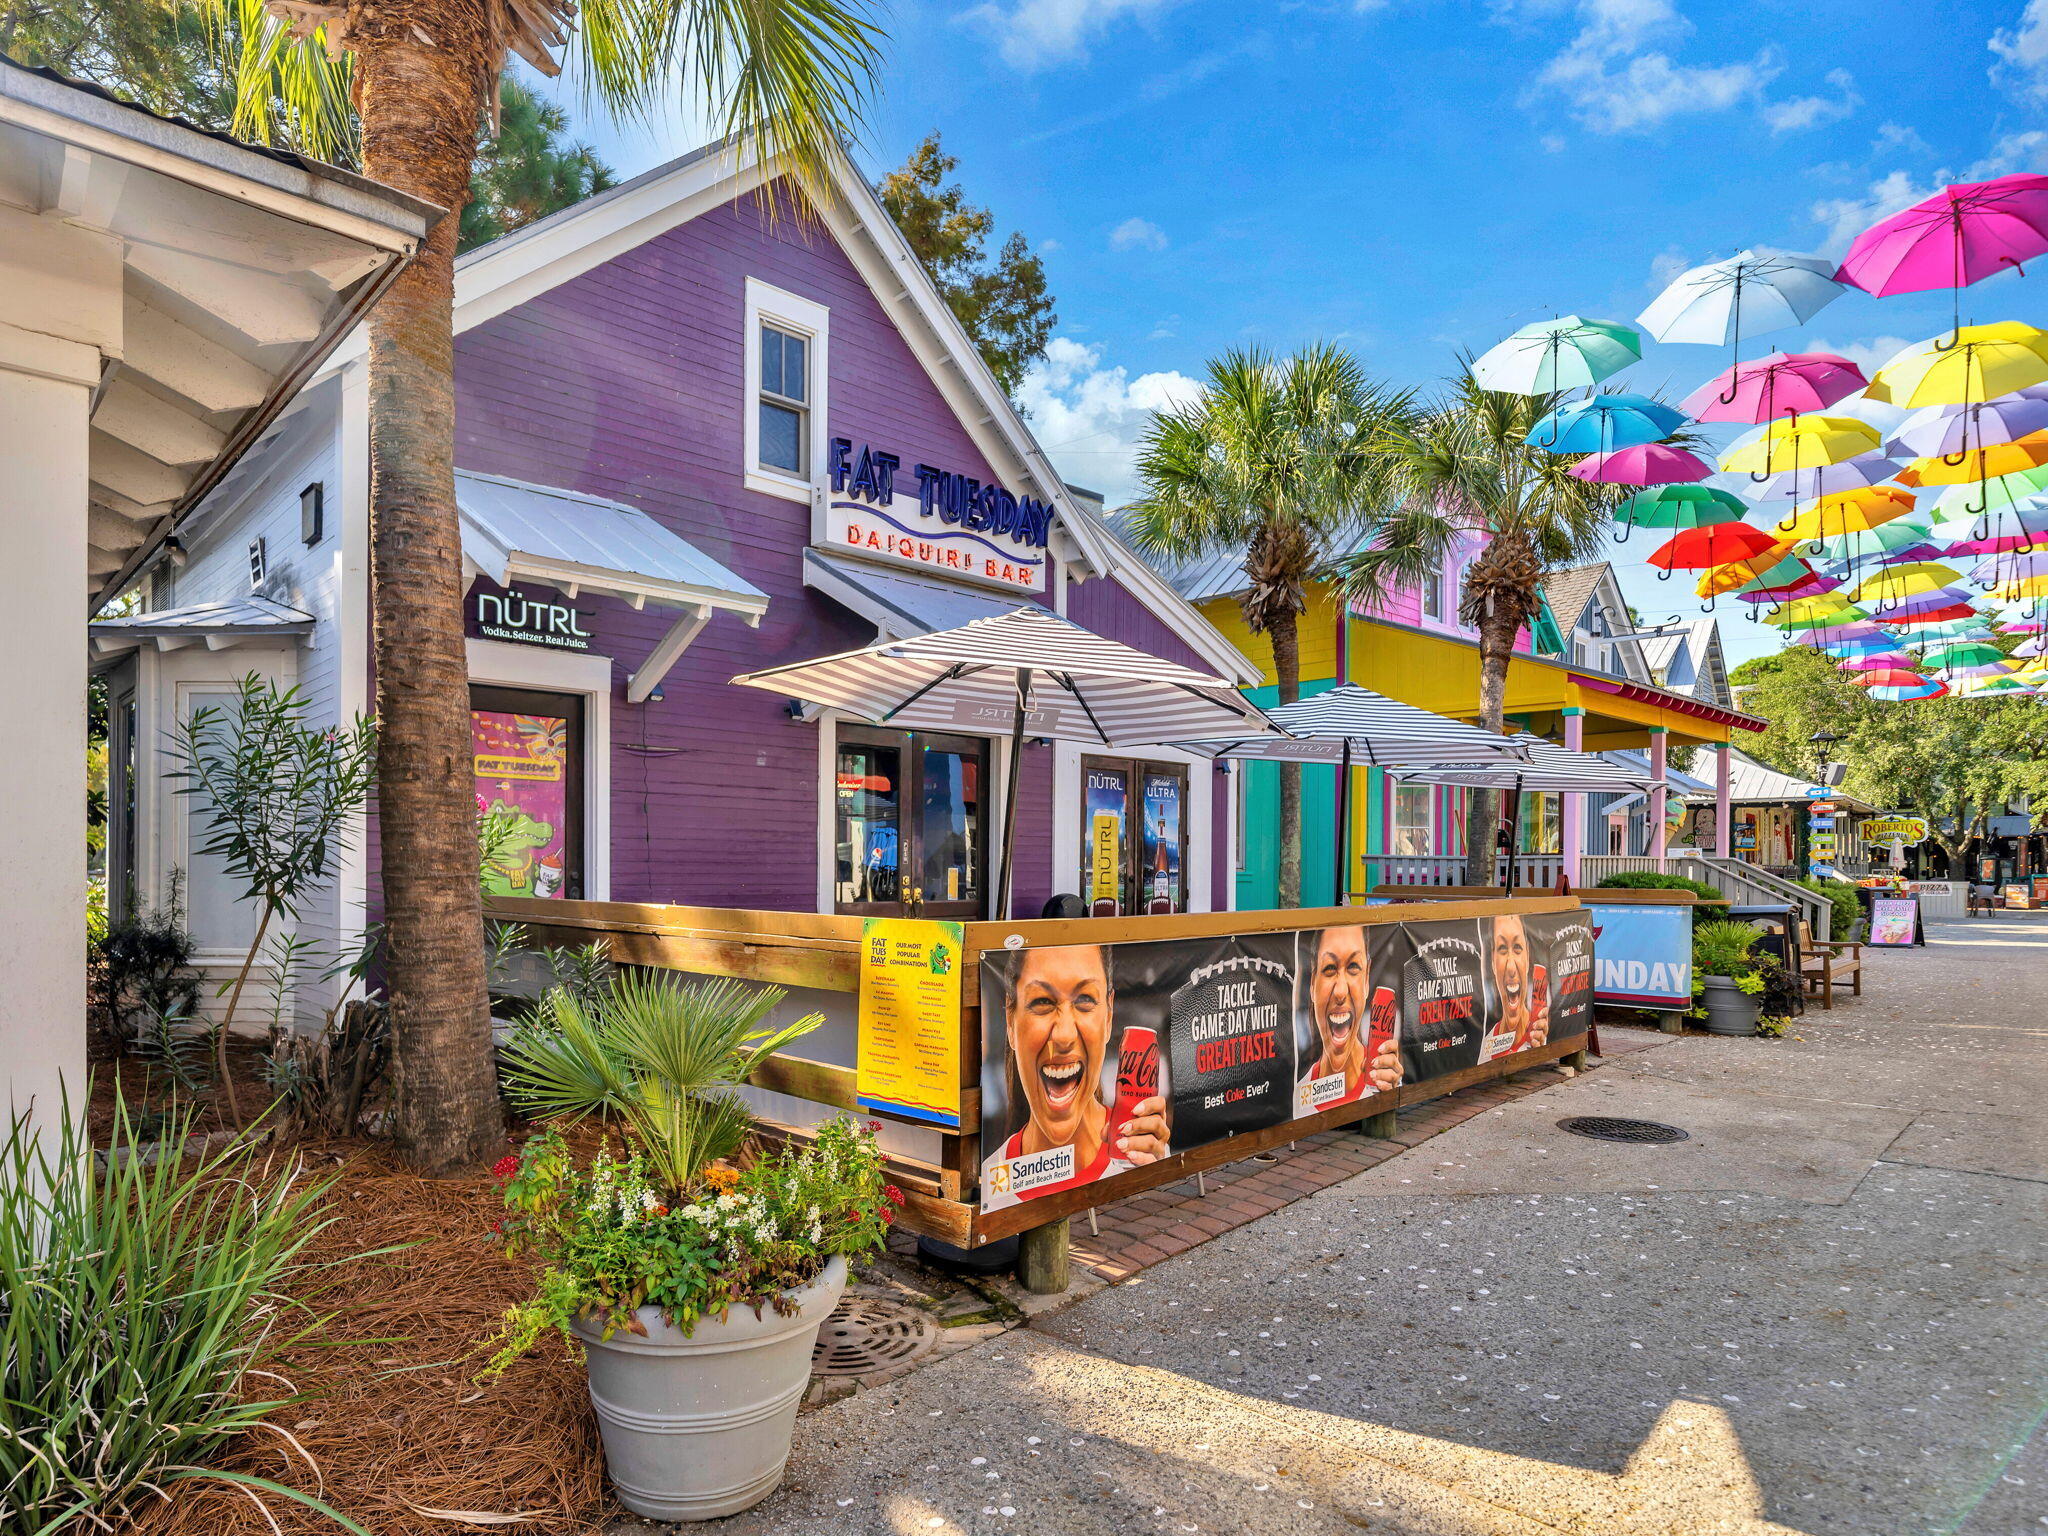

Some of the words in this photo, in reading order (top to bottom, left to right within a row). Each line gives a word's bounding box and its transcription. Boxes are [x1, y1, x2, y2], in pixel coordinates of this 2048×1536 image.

[831, 437, 900, 507] FAT
[914, 463, 1054, 549] TUESDAY
[847, 524, 973, 570] DAIQUIRI
[985, 559, 1034, 586] BAR
[546, 634, 564, 646] Real
[564, 637, 589, 649] Juice.
[839, 790, 854, 798] OPEN
[1147, 787, 1176, 799] ULTRA
[1920, 884, 1950, 892] PIZZA
[871, 938, 887, 948] FAT
[871, 947, 887, 956] TUES
[870, 955, 886, 965] DAY
[889, 959, 928, 968] COMBINATIONS
[1433, 956, 1458, 978] TACKLE
[1594, 959, 1687, 994] UNDAY
[1217, 981, 1257, 1010] TACKLE
[1417, 979, 1441, 1001] GAME
[1442, 977, 1455, 998] DAY
[1455, 974, 1474, 996] WITH
[1419, 1000, 1447, 1025] GREAT
[1449, 995, 1473, 1020] TASTE
[1191, 1012, 1225, 1041] GAME
[1228, 1008, 1249, 1035] DAY
[1250, 1003, 1278, 1031] WITH
[1196, 1038, 1237, 1074] GREAT
[1239, 1030, 1276, 1064] TASTE
[1423, 1040, 1438, 1053] Best
[1451, 1034, 1467, 1047] Ever?
[1204, 1092, 1225, 1110] Best
[1225, 1088, 1246, 1104] Coke
[1246, 1080, 1270, 1098] Ever?
[1312, 1077, 1343, 1096] Sandestin
[1012, 1151, 1071, 1180] Sandestin
[1012, 1181, 1024, 1190] Golf
[1025, 1178, 1035, 1186] and
[1036, 1174, 1053, 1184] Beach
[1053, 1169, 1071, 1180] Resort
